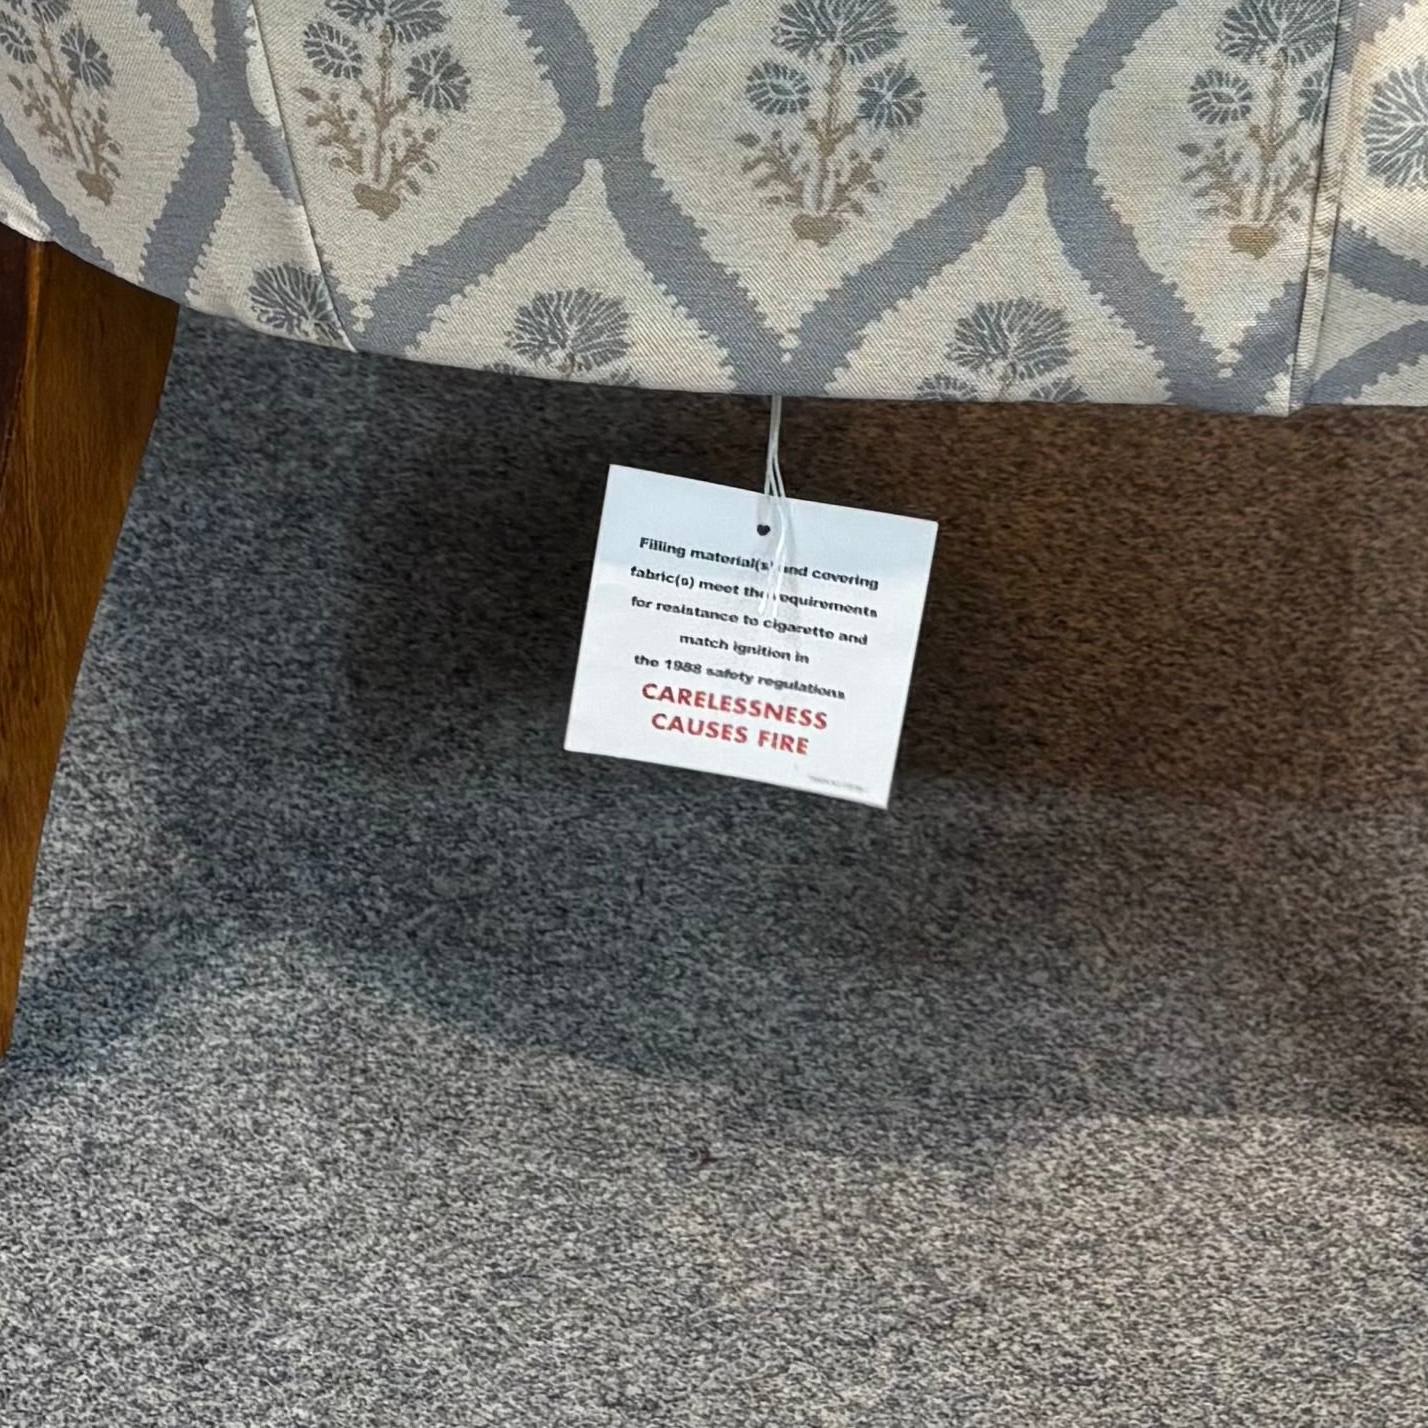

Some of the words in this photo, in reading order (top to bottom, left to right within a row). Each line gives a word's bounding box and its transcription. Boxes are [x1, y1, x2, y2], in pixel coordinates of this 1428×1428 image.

[630, 565, 695, 590] fabric(s)
[698, 579, 739, 595] meet
[639, 536, 686, 558] Filling
[811, 568, 879, 592] covering
[630, 596, 653, 609] for
[656, 602, 739, 624] resistance
[743, 614, 759, 627] to
[763, 618, 834, 641] cigarette
[838, 632, 868, 646] and
[679, 633, 729, 651] match
[733, 640, 791, 662] ignition
[794, 651, 810, 664] in
[634, 654, 659, 668] the
[665, 659, 702, 675] 1988
[705, 665, 754, 684] safety
[757, 675, 846, 700] regulations
[641, 682, 828, 730] CARELESSNESS
[651, 712, 749, 744] CAUSES
[757, 729, 810, 755] FIRE
